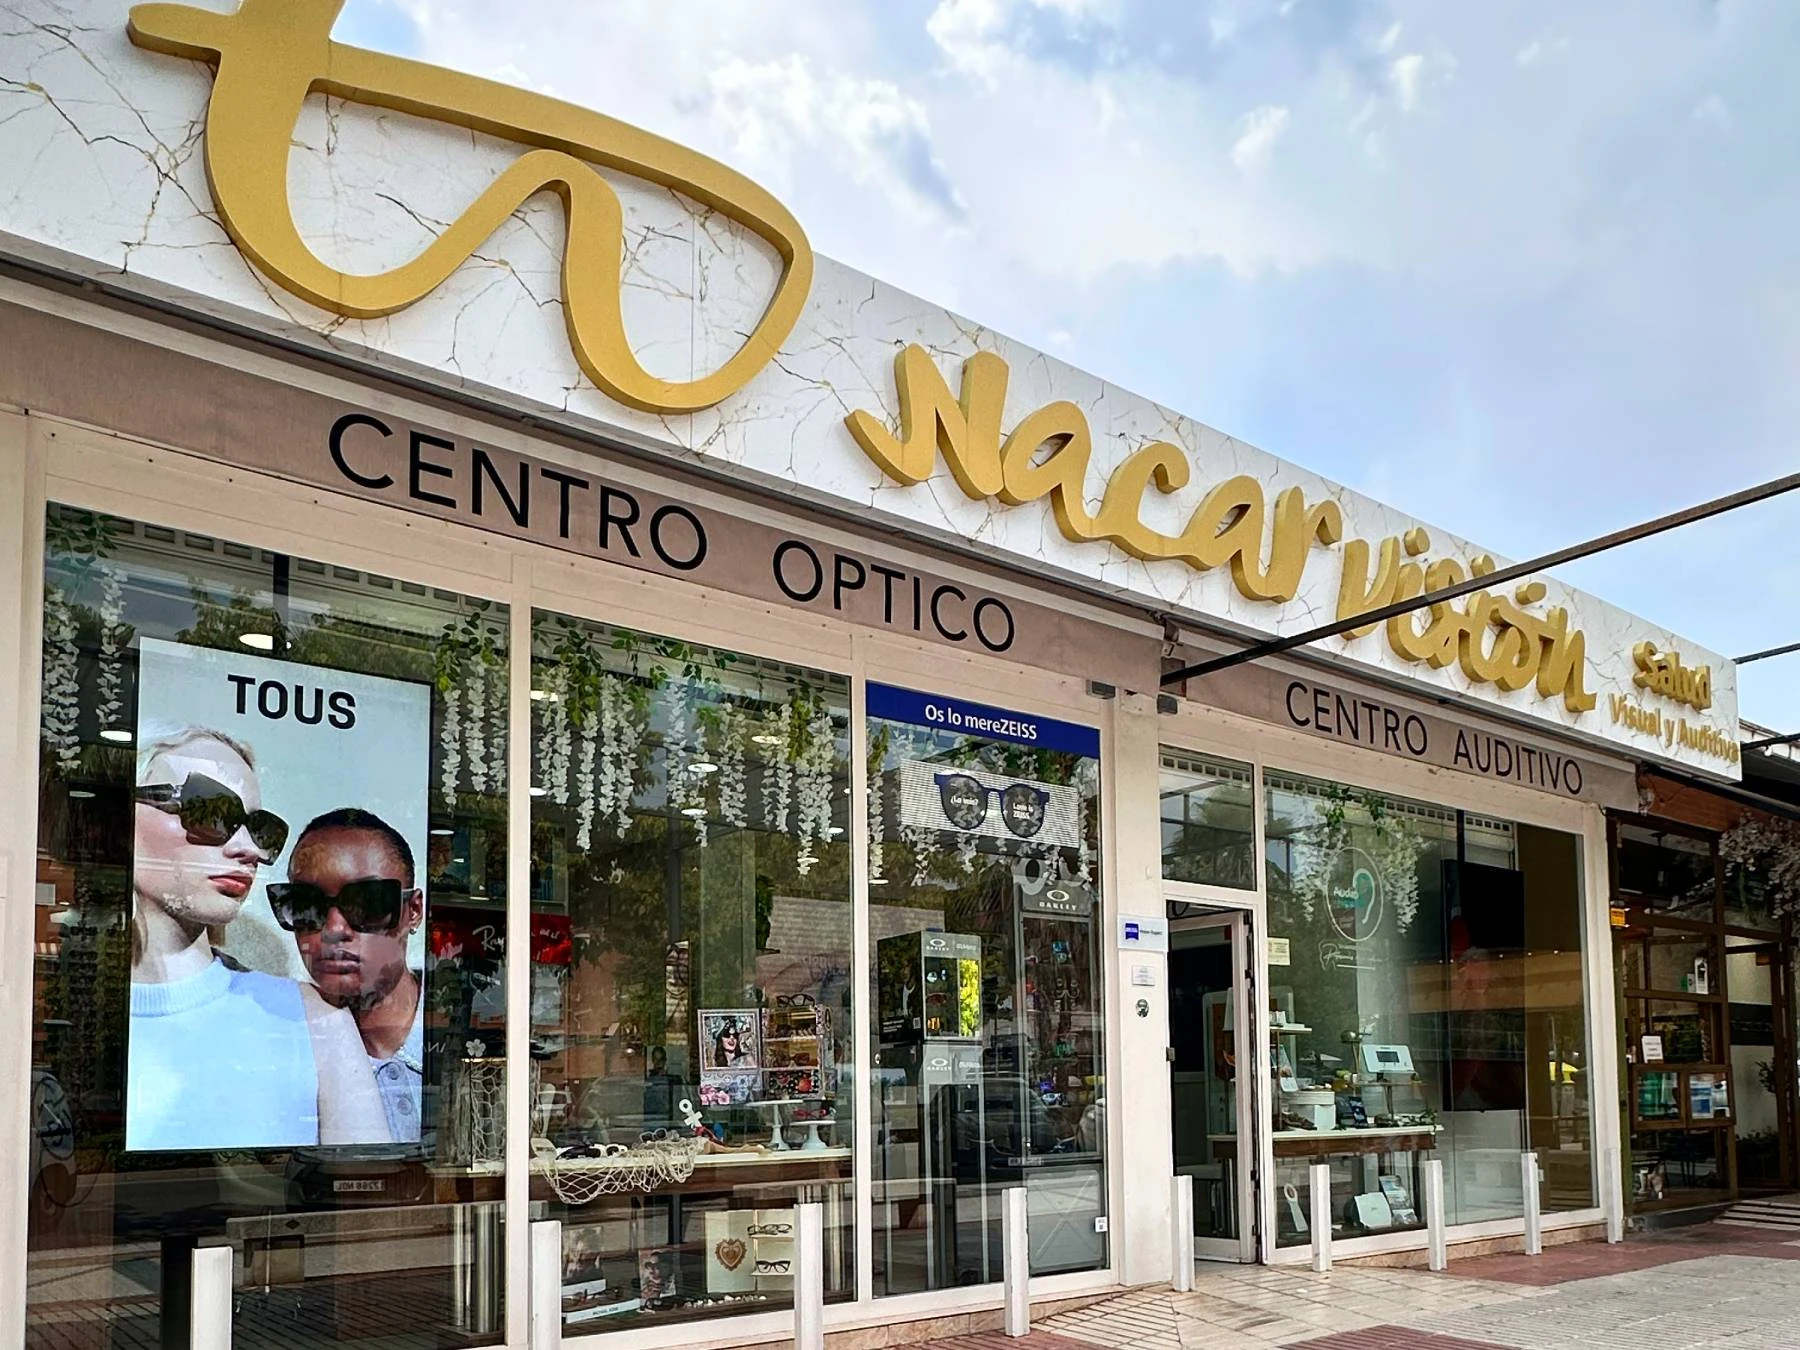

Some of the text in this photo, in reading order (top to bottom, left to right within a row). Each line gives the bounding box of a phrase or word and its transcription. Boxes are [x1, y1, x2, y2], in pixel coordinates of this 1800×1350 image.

[844, 343, 1342, 603] Nacar
[329, 413, 1015, 652] CENTRO OPTICO
[227, 674, 356, 730] TOUS
[1633, 640, 1712, 712] Salud
[925, 704, 1038, 740] Os lo mereZEISS
[1286, 681, 1583, 795] CENTRO AUDITIVO
[1608, 693, 1740, 764] Visual y Auditiva
[1039, 901, 1077, 911] OAKLEY
